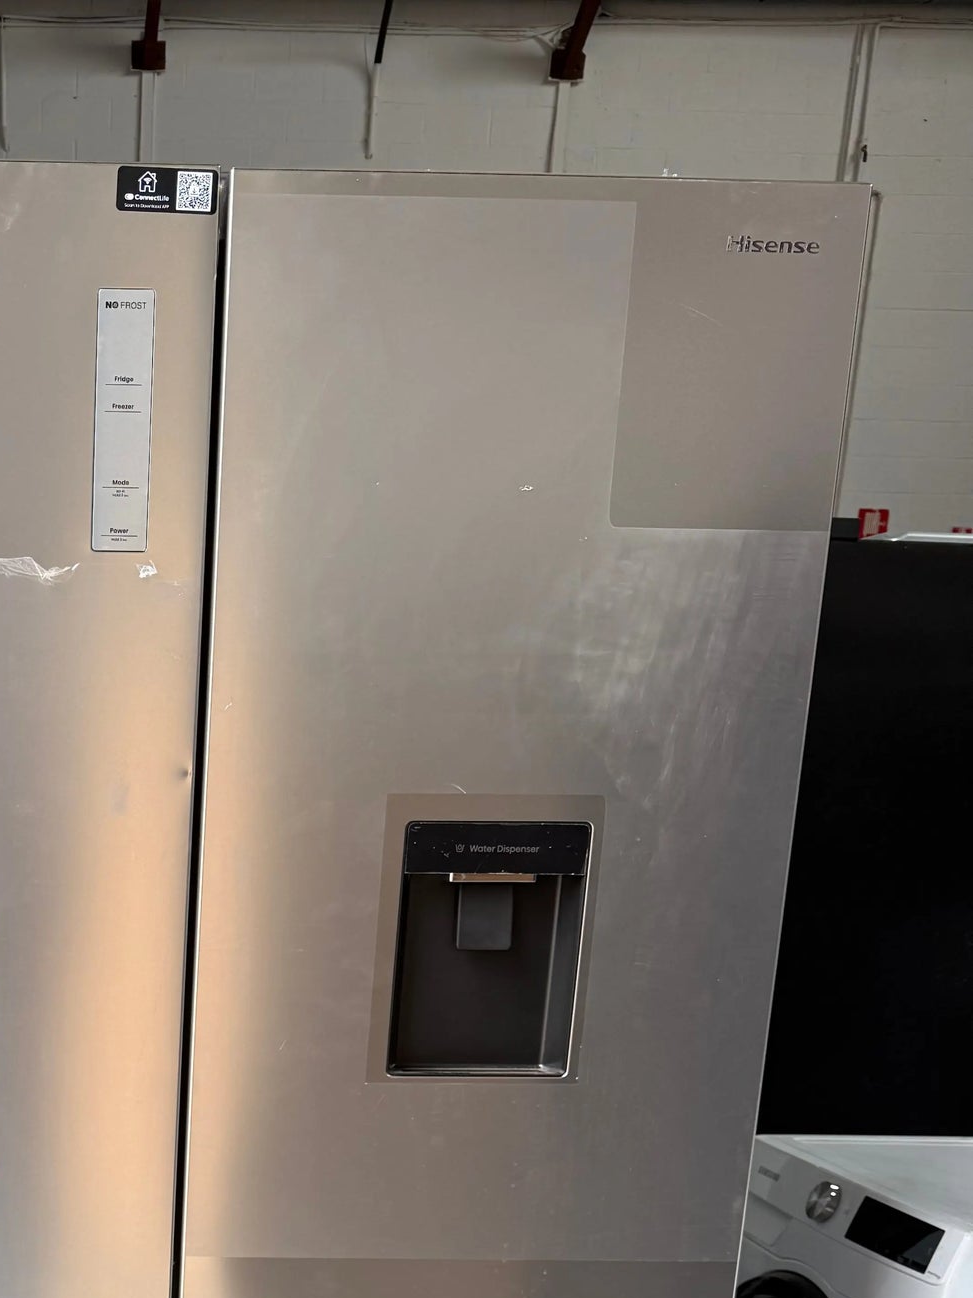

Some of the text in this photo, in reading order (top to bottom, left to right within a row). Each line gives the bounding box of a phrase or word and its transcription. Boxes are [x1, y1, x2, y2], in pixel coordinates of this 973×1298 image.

[135, 194, 170, 202] ConnectLife
[726, 235, 820, 254] Hisense
[105, 301, 147, 309] NO FROST
[114, 375, 134, 383] Fridge
[469, 844, 540, 855] Water Dispenser
